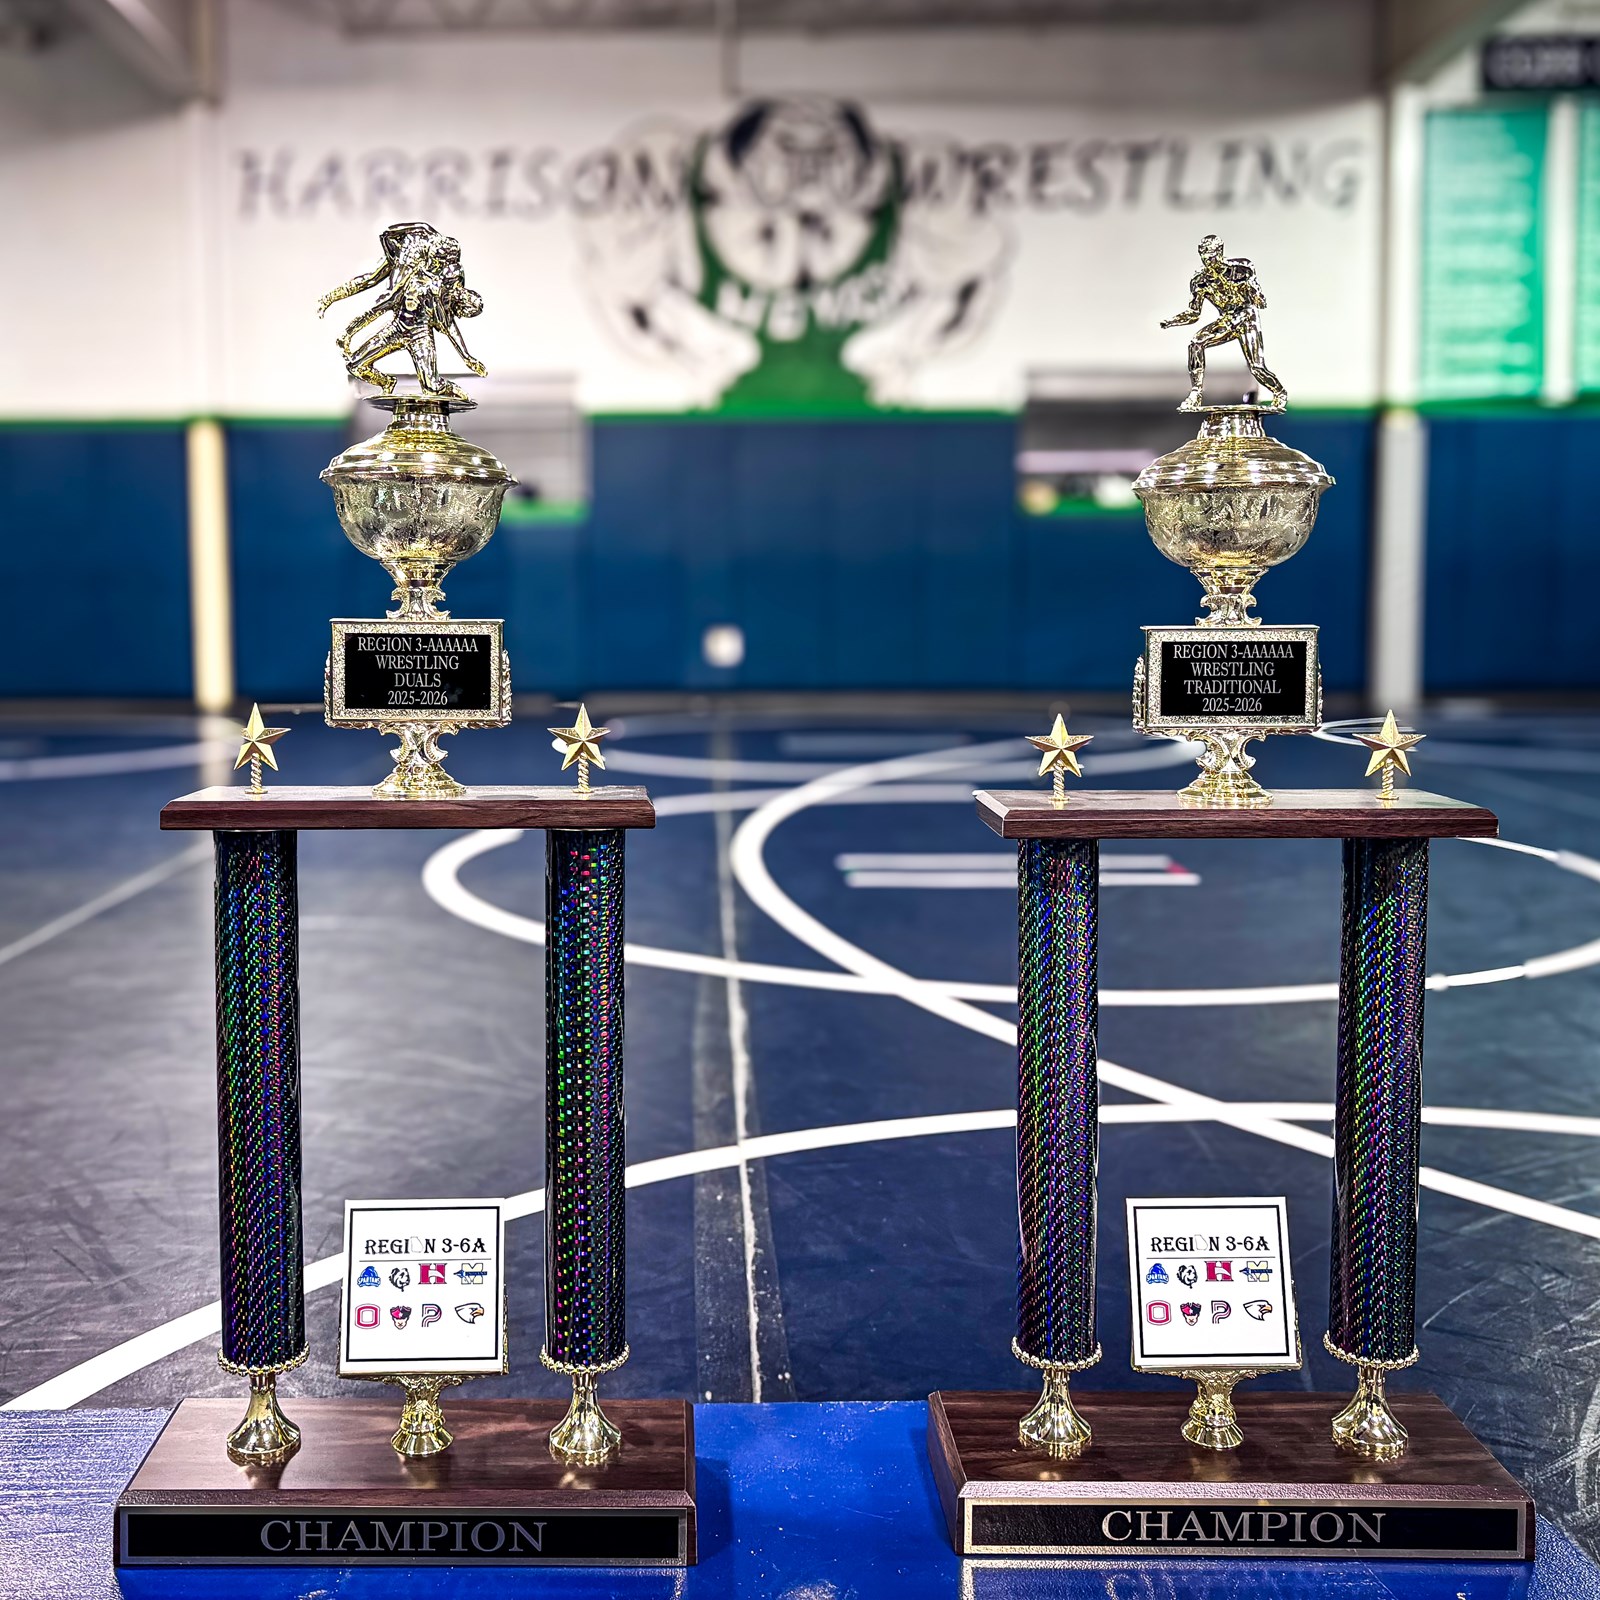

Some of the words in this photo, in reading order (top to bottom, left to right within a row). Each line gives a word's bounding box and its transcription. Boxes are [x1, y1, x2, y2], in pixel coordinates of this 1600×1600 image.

[236, 144, 682, 220] HARRISON
[898, 137, 1366, 220] WRESTLING
[357, 636, 412, 652] REGION
[415, 637, 479, 653] 3-AAAAAA
[1173, 644, 1228, 659] REGION
[1231, 644, 1294, 659] 3-AAAAAA
[375, 654, 460, 670] WRESTLING
[1190, 661, 1275, 677] WRESTLING
[394, 672, 442, 688] DUALS
[1184, 679, 1282, 694] TRADITIONAL
[387, 690, 448, 706] 2025-2026
[1202, 697, 1263, 712] 2025-2026
[441, 1237, 487, 1253] 3-6A
[1225, 1235, 1271, 1252] 3-6A
[1100, 1509, 1386, 1544] CHAMPION
[259, 1519, 548, 1553] CHAMPION
